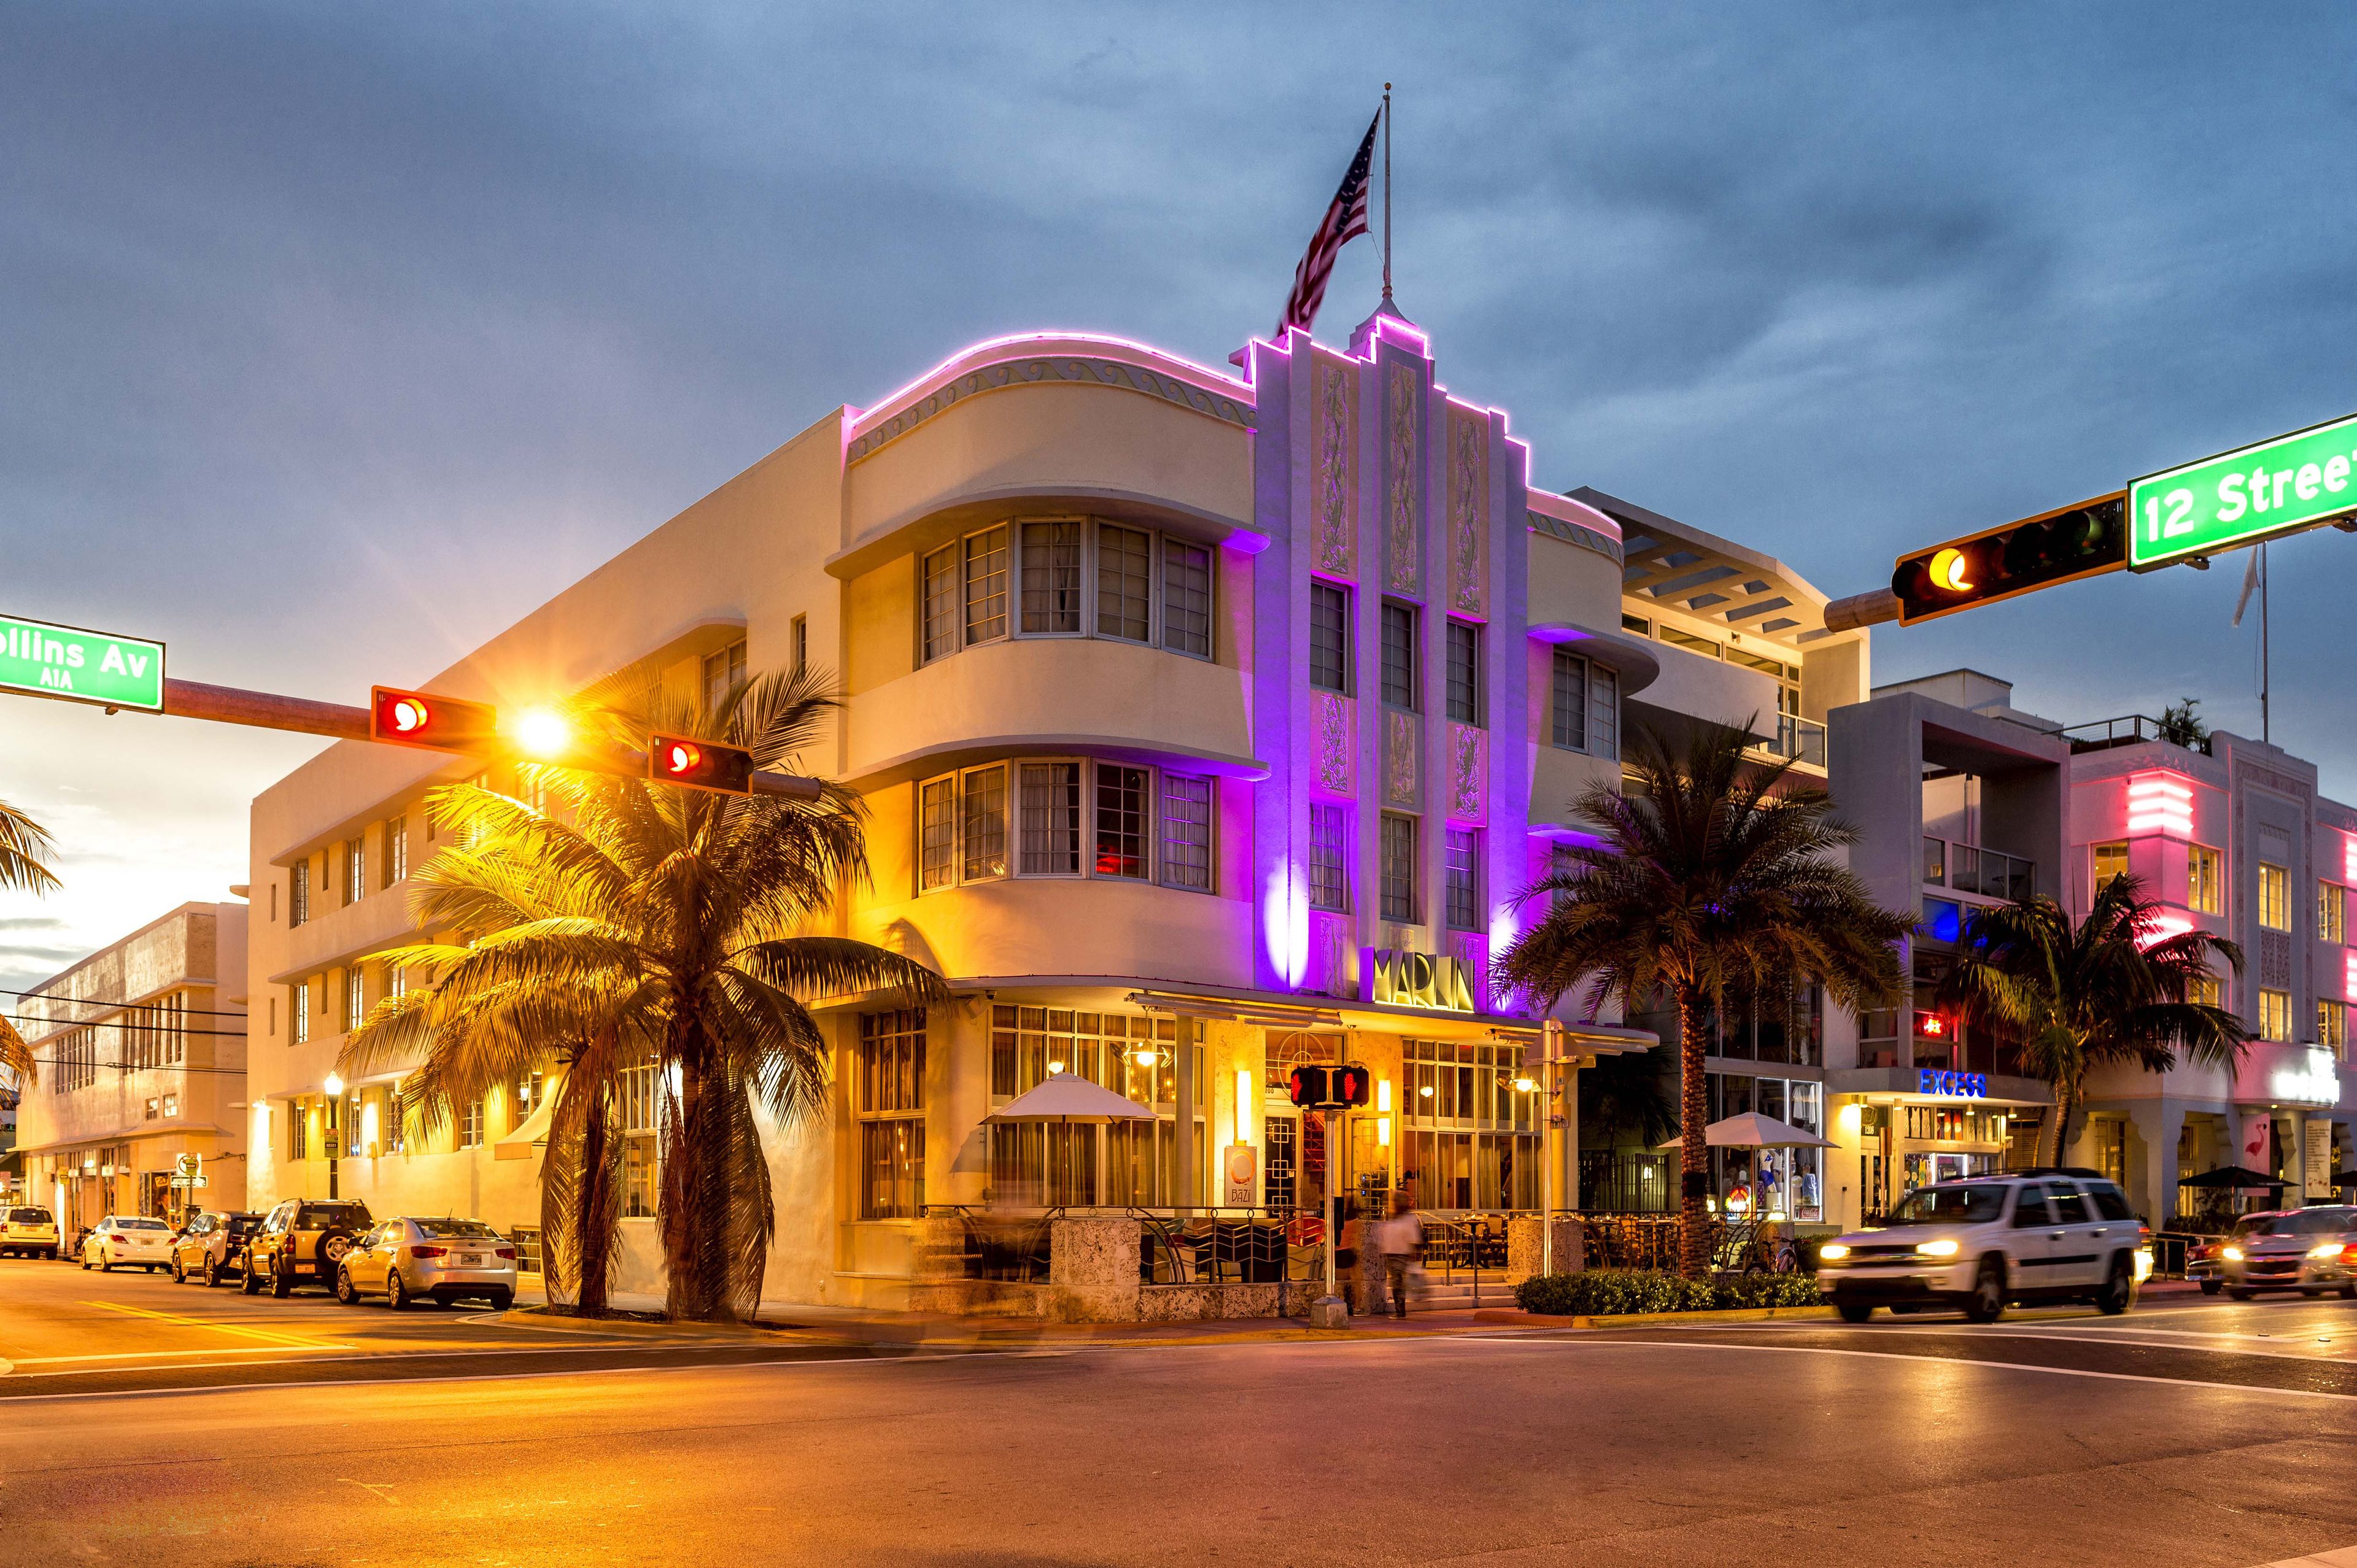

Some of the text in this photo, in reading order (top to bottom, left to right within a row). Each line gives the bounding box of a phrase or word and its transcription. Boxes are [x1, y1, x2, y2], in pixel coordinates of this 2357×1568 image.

[2145, 449, 2357, 543] 12 Stree
[100, 644, 148, 678] Av
[40, 667, 73, 690] A1A
[1359, 946, 1474, 1013] MARLIN
[1920, 1069, 1986, 1098] EXCESS
